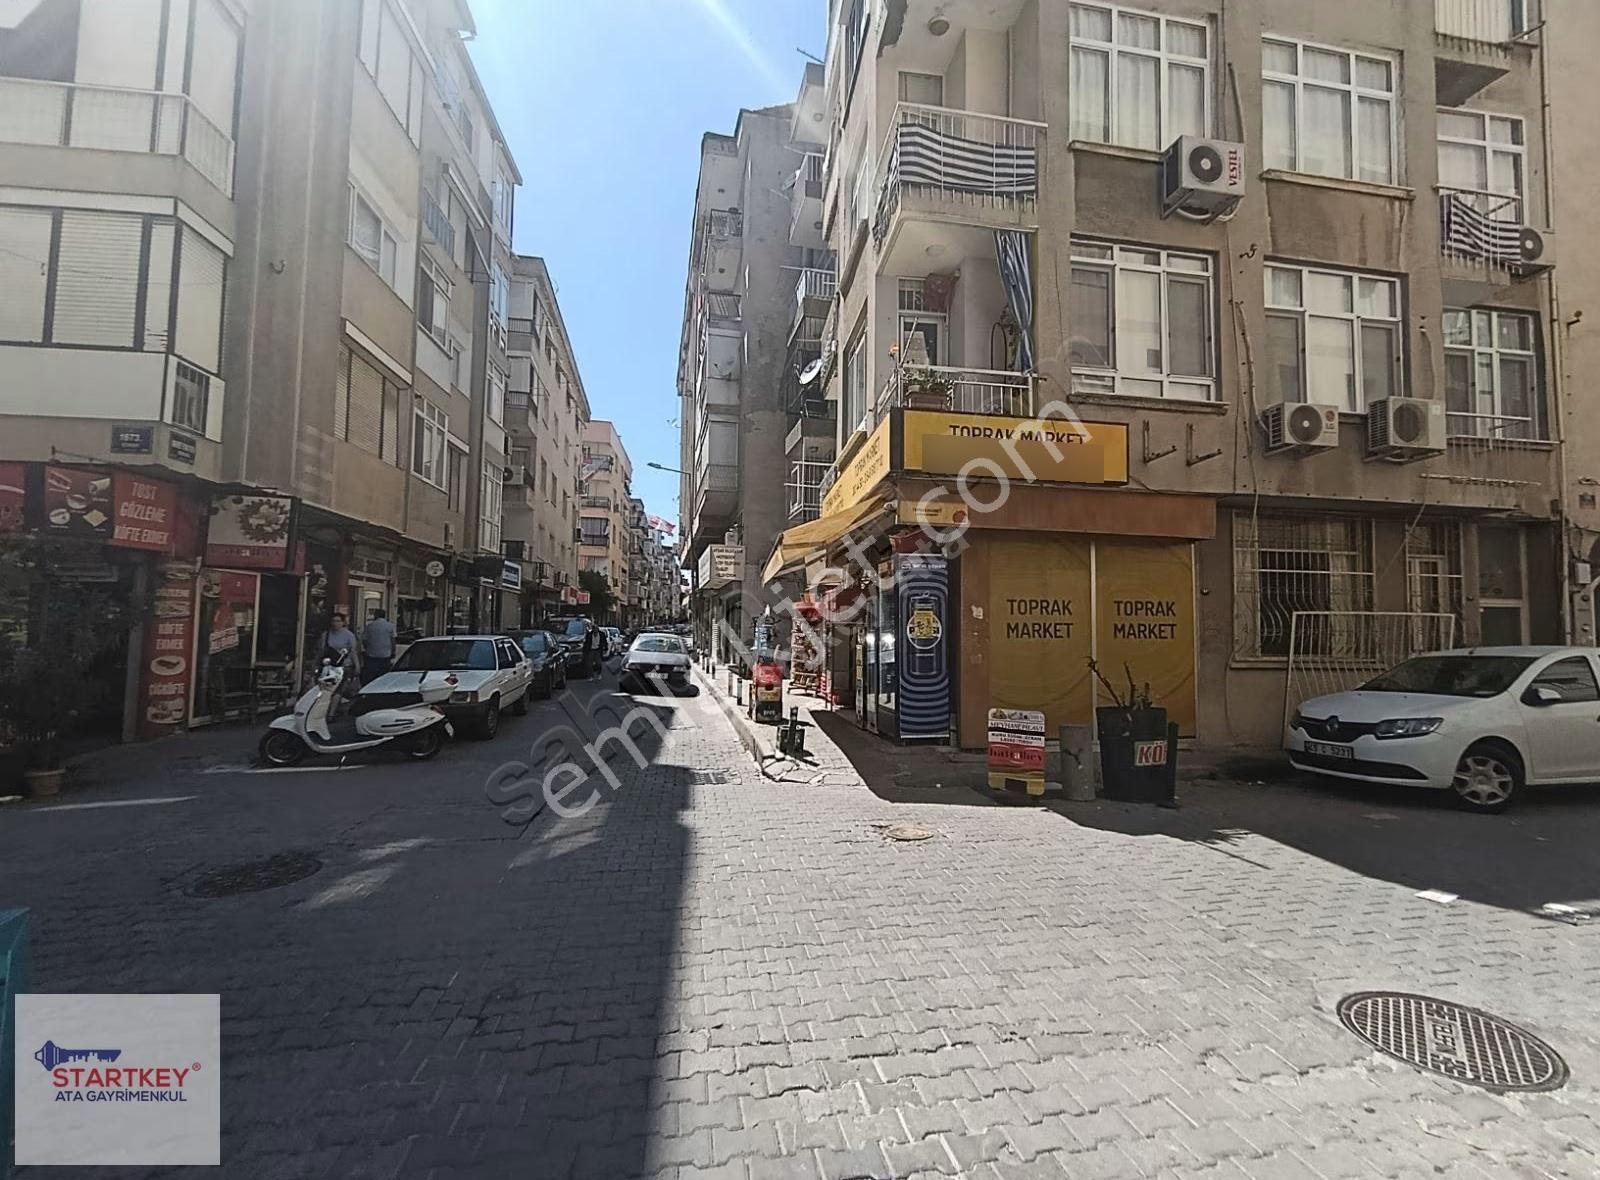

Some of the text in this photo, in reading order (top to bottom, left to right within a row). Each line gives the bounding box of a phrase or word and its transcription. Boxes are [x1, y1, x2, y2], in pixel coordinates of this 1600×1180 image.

[1228, 149, 1238, 187] VESTEL
[1006, 599, 1073, 616] TOPRAK
[1114, 600, 1176, 617] TOPRAK
[1006, 622, 1074, 639] MARKET
[1113, 623, 1177, 640] MARKET
[1137, 741, 1167, 764] KÖ
